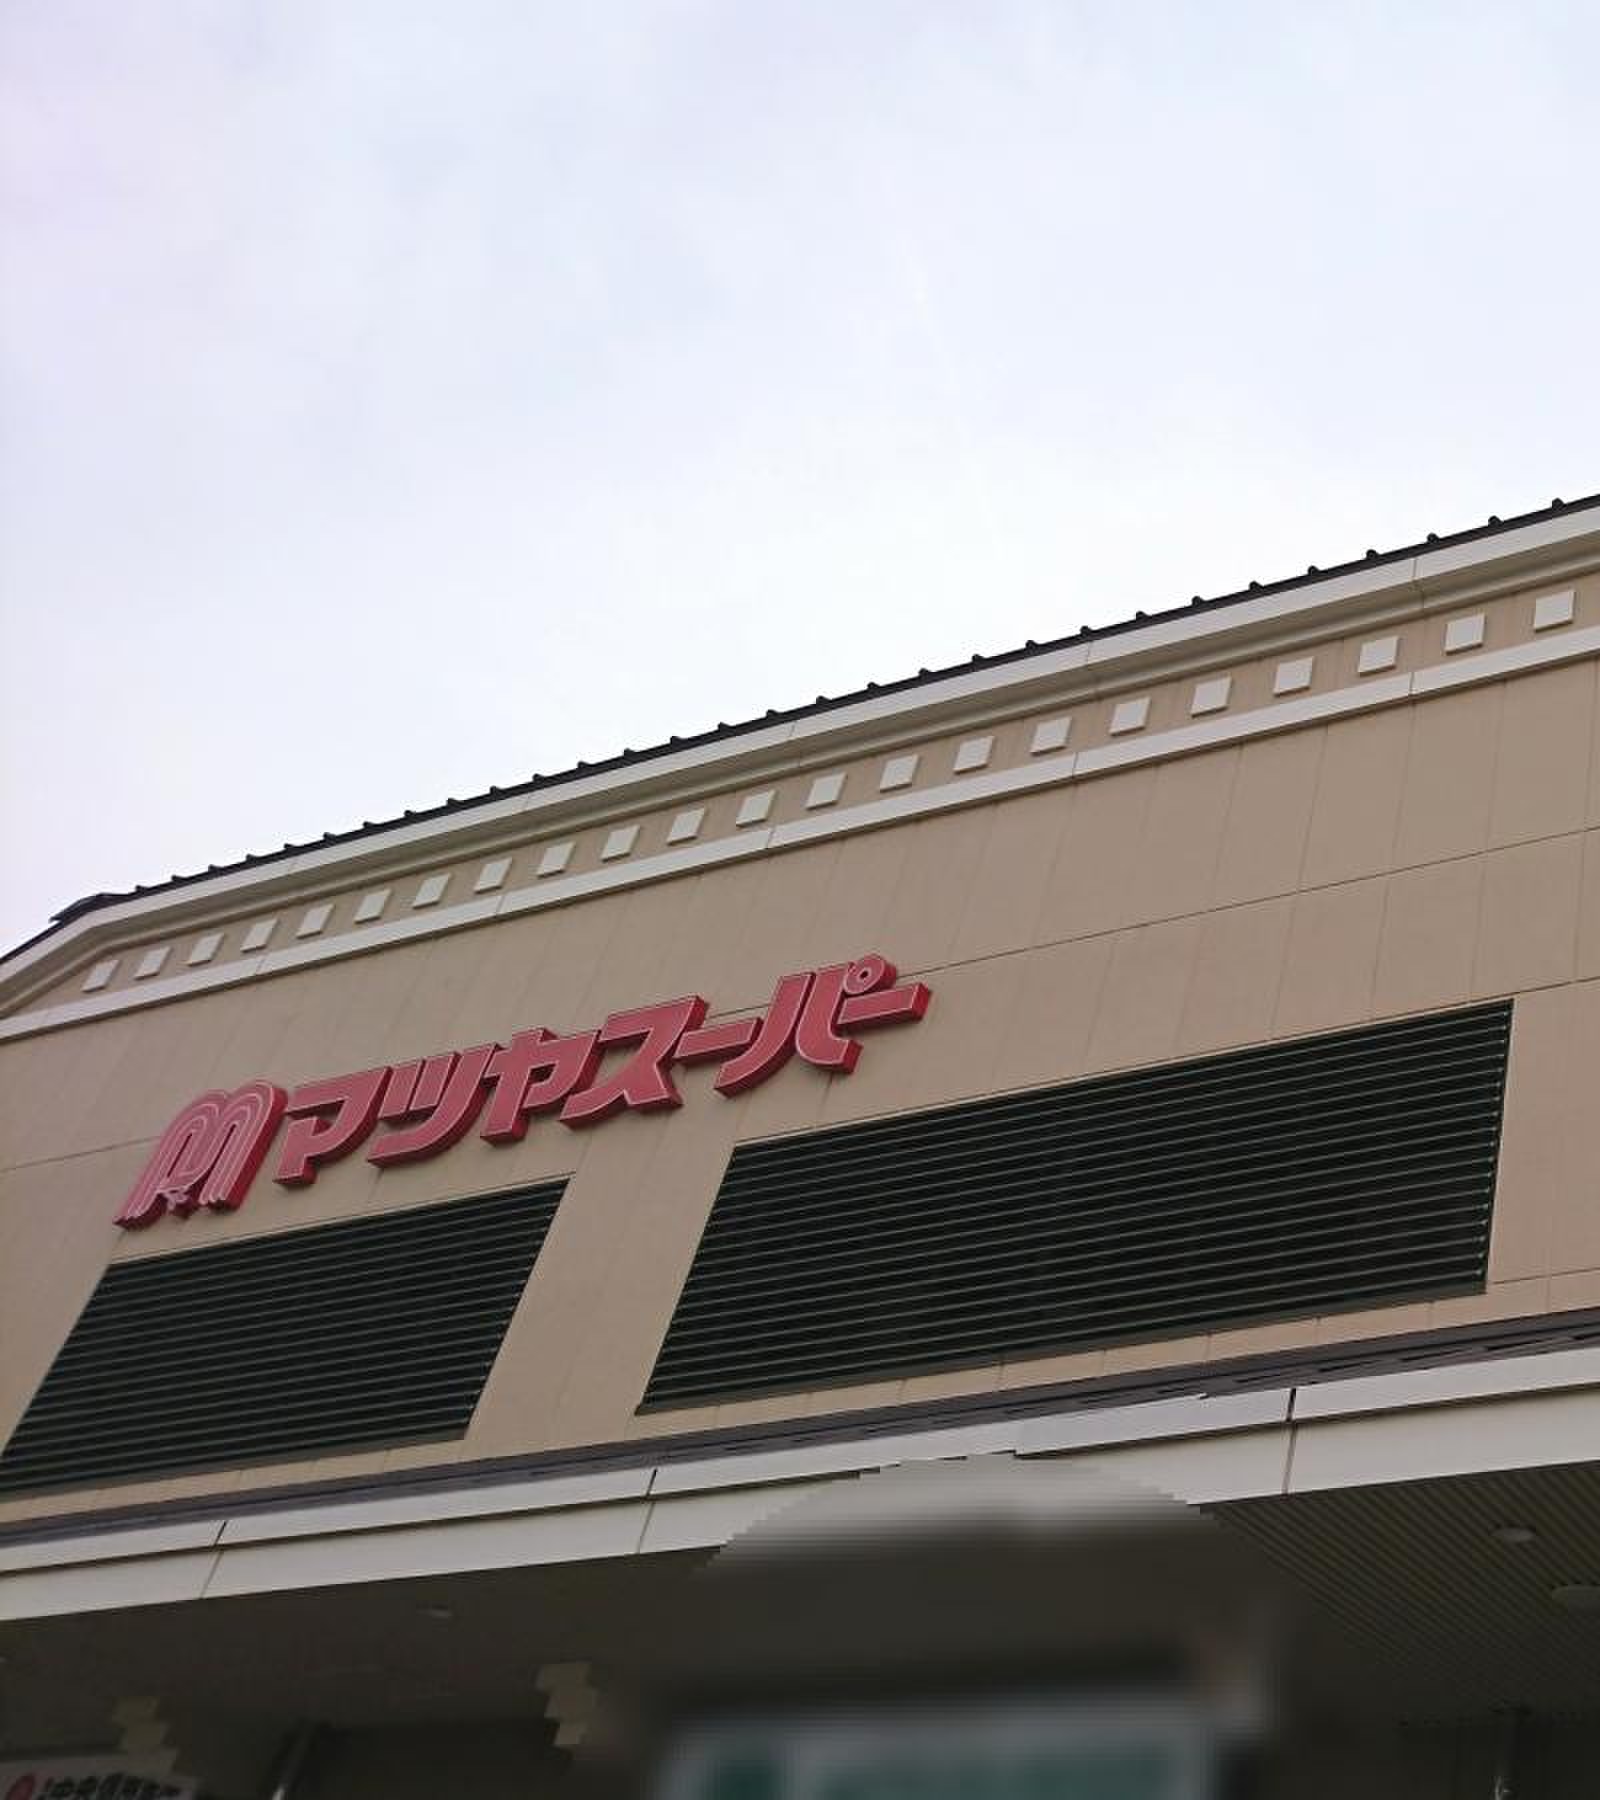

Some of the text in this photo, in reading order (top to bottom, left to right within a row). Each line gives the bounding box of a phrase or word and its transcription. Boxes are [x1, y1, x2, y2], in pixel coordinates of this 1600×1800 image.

[272, 953, 932, 1186] マツヤスーパー
